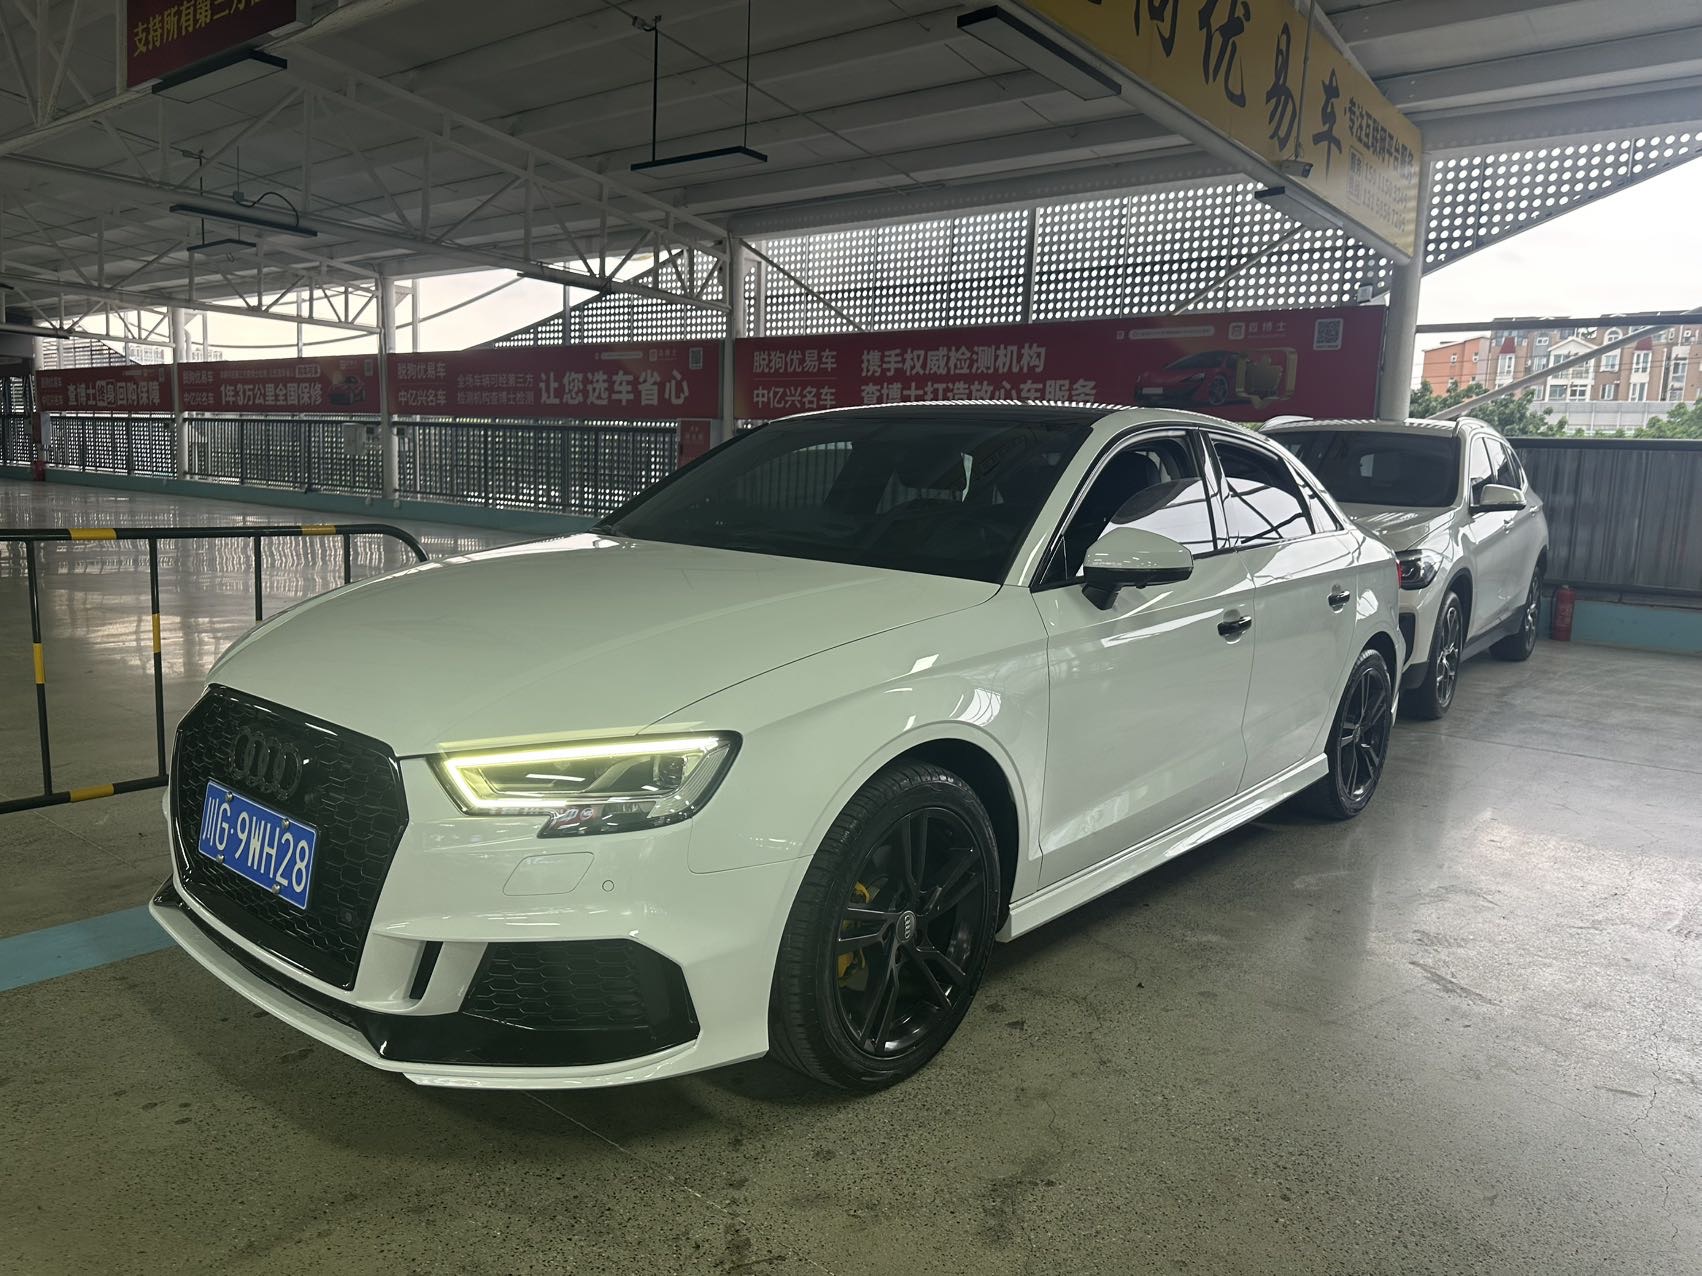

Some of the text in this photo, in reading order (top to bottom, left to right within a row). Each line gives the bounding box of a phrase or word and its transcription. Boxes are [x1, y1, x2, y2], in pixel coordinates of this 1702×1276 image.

[133, 0, 263, 57] 支持所有第三
[753, 349, 838, 375] 脱狗优易车
[861, 343, 1046, 377] 携手权威检测机构
[398, 388, 448, 407] 中亿兴名车
[538, 369, 689, 407] 让您选车省心
[753, 386, 837, 410] 中亿兴名车
[202, 797, 308, 893] 川G·9WH28
